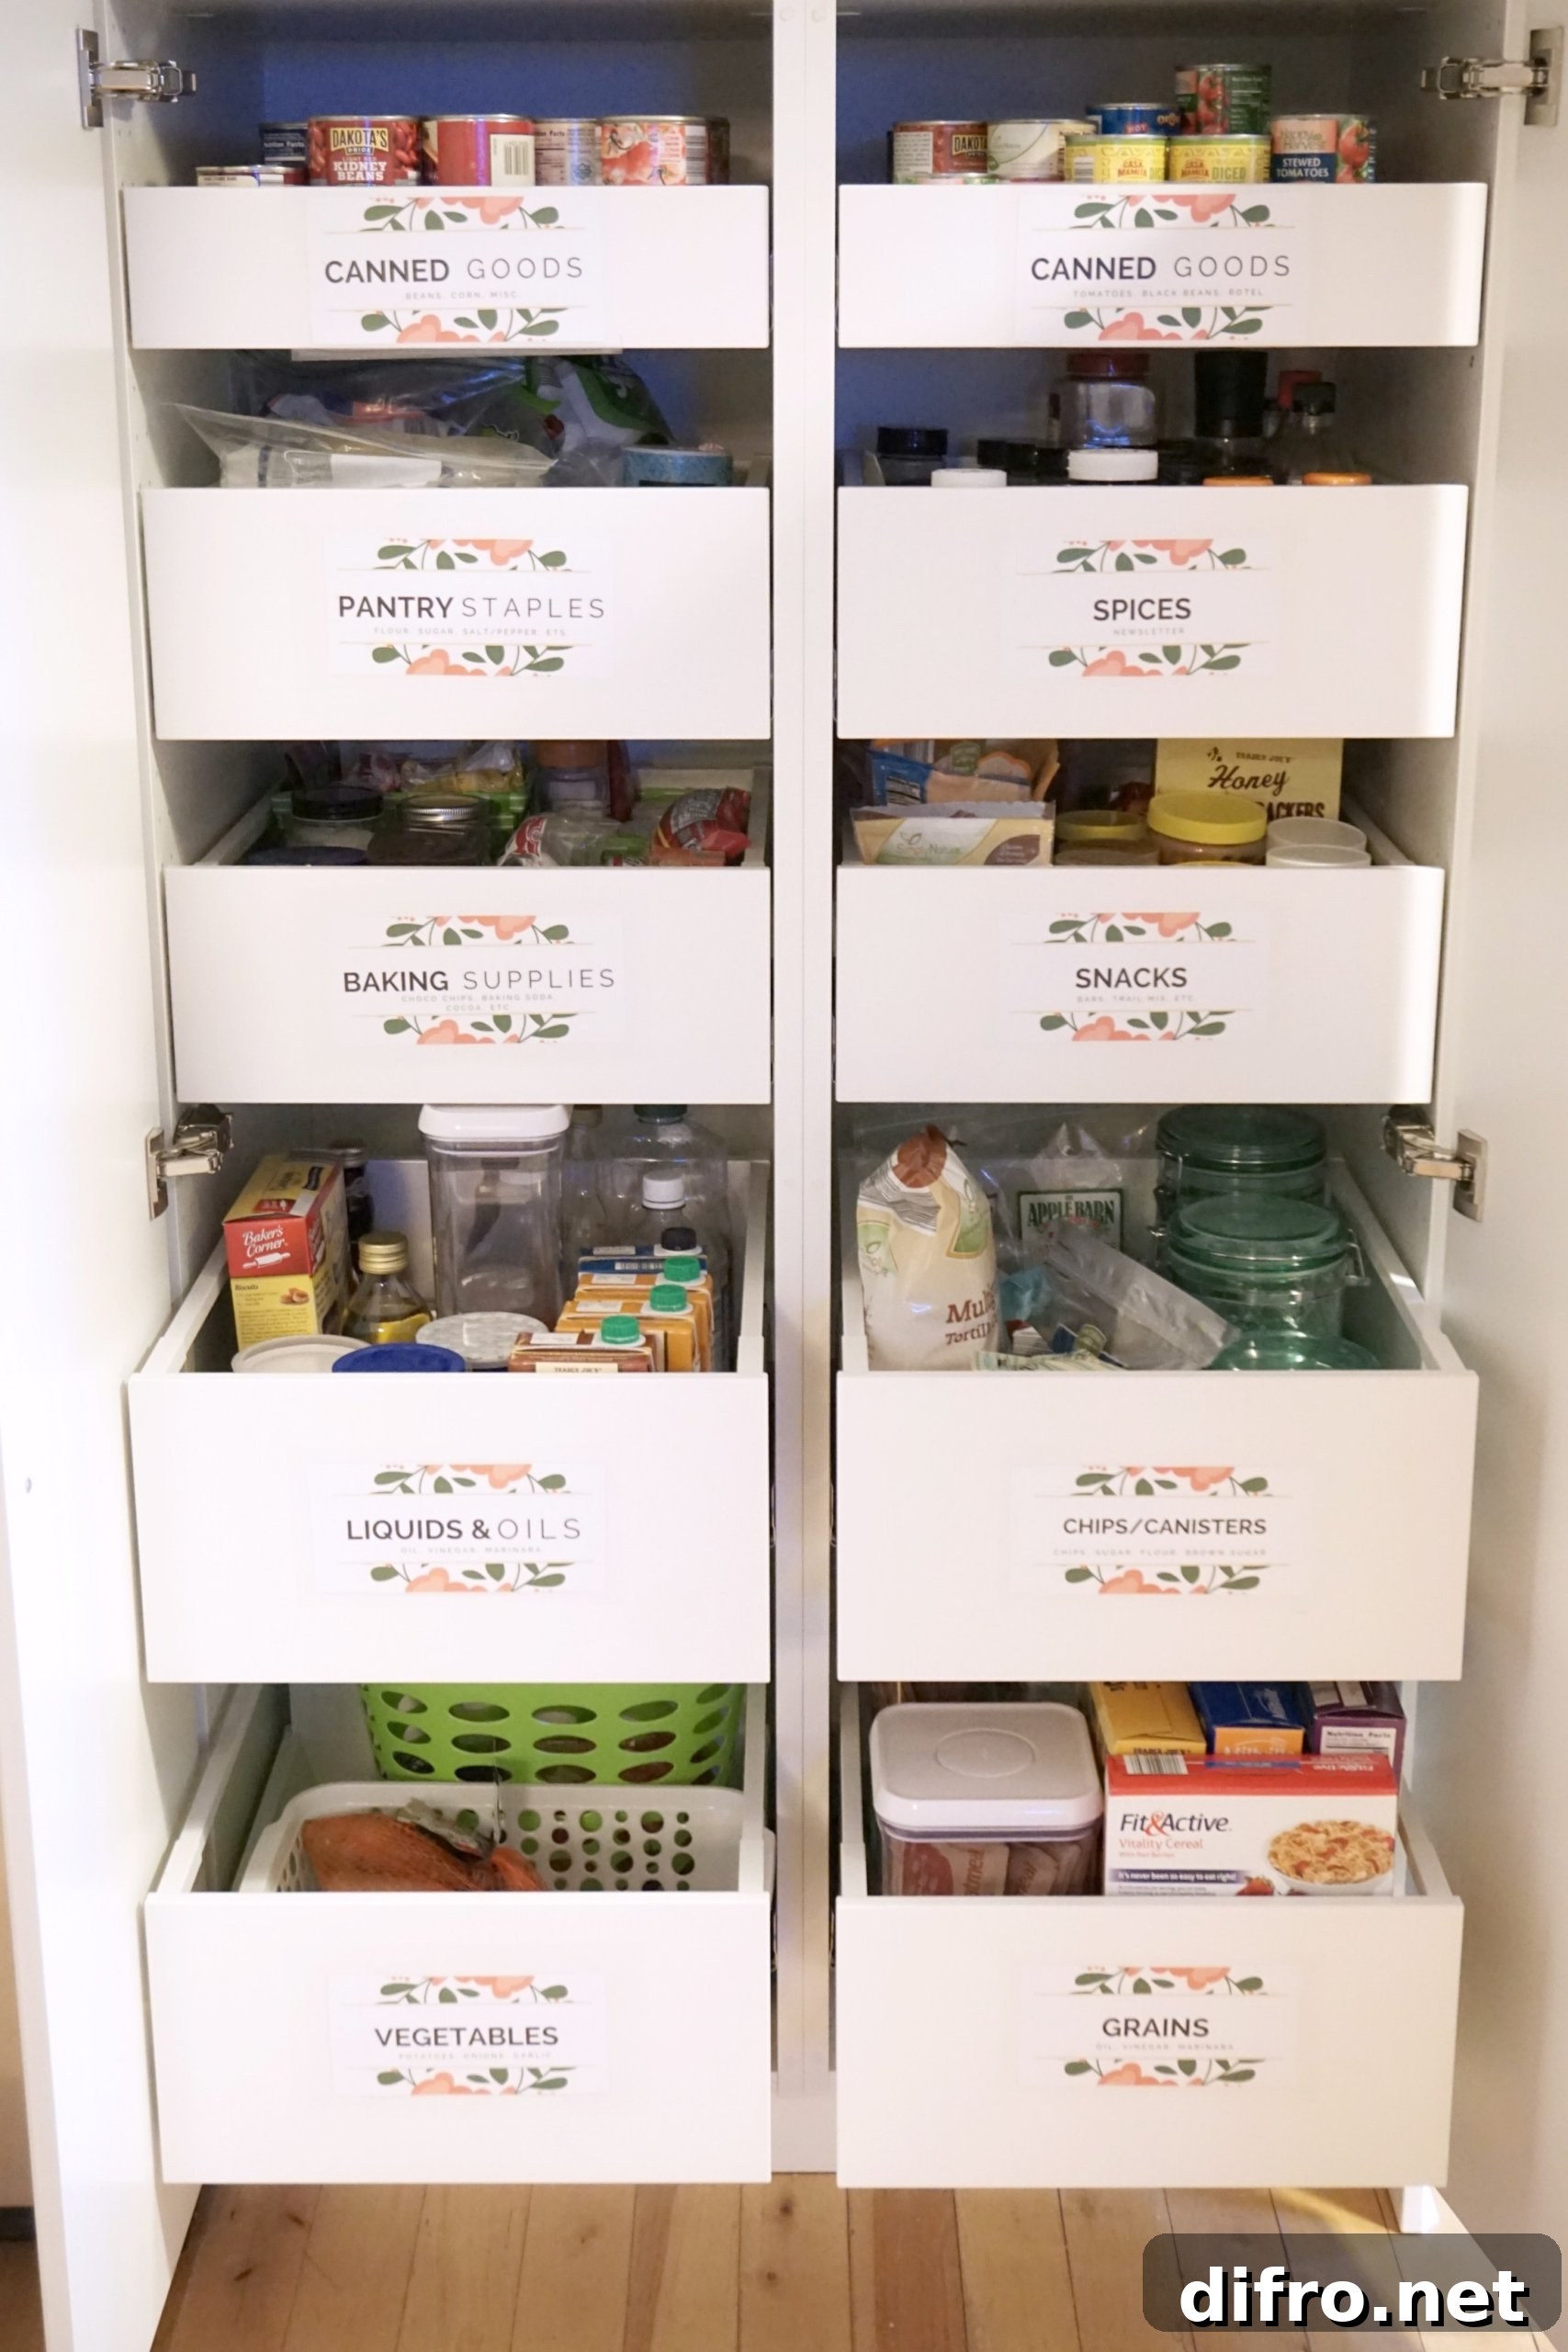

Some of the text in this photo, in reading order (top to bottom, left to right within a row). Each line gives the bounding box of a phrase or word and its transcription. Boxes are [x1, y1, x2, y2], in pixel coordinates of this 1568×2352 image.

[332, 128, 389, 149] DAKOTA'S
[333, 162, 387, 172] KIDNEY
[1282, 157, 1321, 167] STEWED
[337, 171, 385, 181] BEANS
[1213, 167, 1247, 179] DICED
[1277, 168, 1329, 177] TOMATOES
[325, 257, 582, 283] CANNED GOODS
[1031, 254, 1290, 280] CANNED GOODS
[339, 595, 604, 618] PANTRY STAPLES
[1093, 598, 1191, 621] SPICES
[1207, 764, 1290, 797] Honey
[1257, 801, 1325, 819] ACKERS
[344, 968, 615, 992] BAKING SUPPLIES
[1076, 967, 1188, 989] SNACKS
[1027, 1200, 1114, 1227] APPLE BARN
[243, 1224, 284, 1246] Baker's
[246, 1238, 286, 1258] Corner
[347, 1518, 581, 1540] LIQUIDS & OILS
[1064, 1518, 1267, 1535] CHIPS/CANISTERS
[1120, 1811, 1230, 1837] Fit&Active
[1118, 1838, 1204, 1850] Vitality Cereal
[1179, 1873, 1195, 1882] easy
[1216, 1872, 1236, 1883] right!
[374, 2027, 558, 2047] VEGETABLES
[1102, 2018, 1210, 2038] GRAINS
